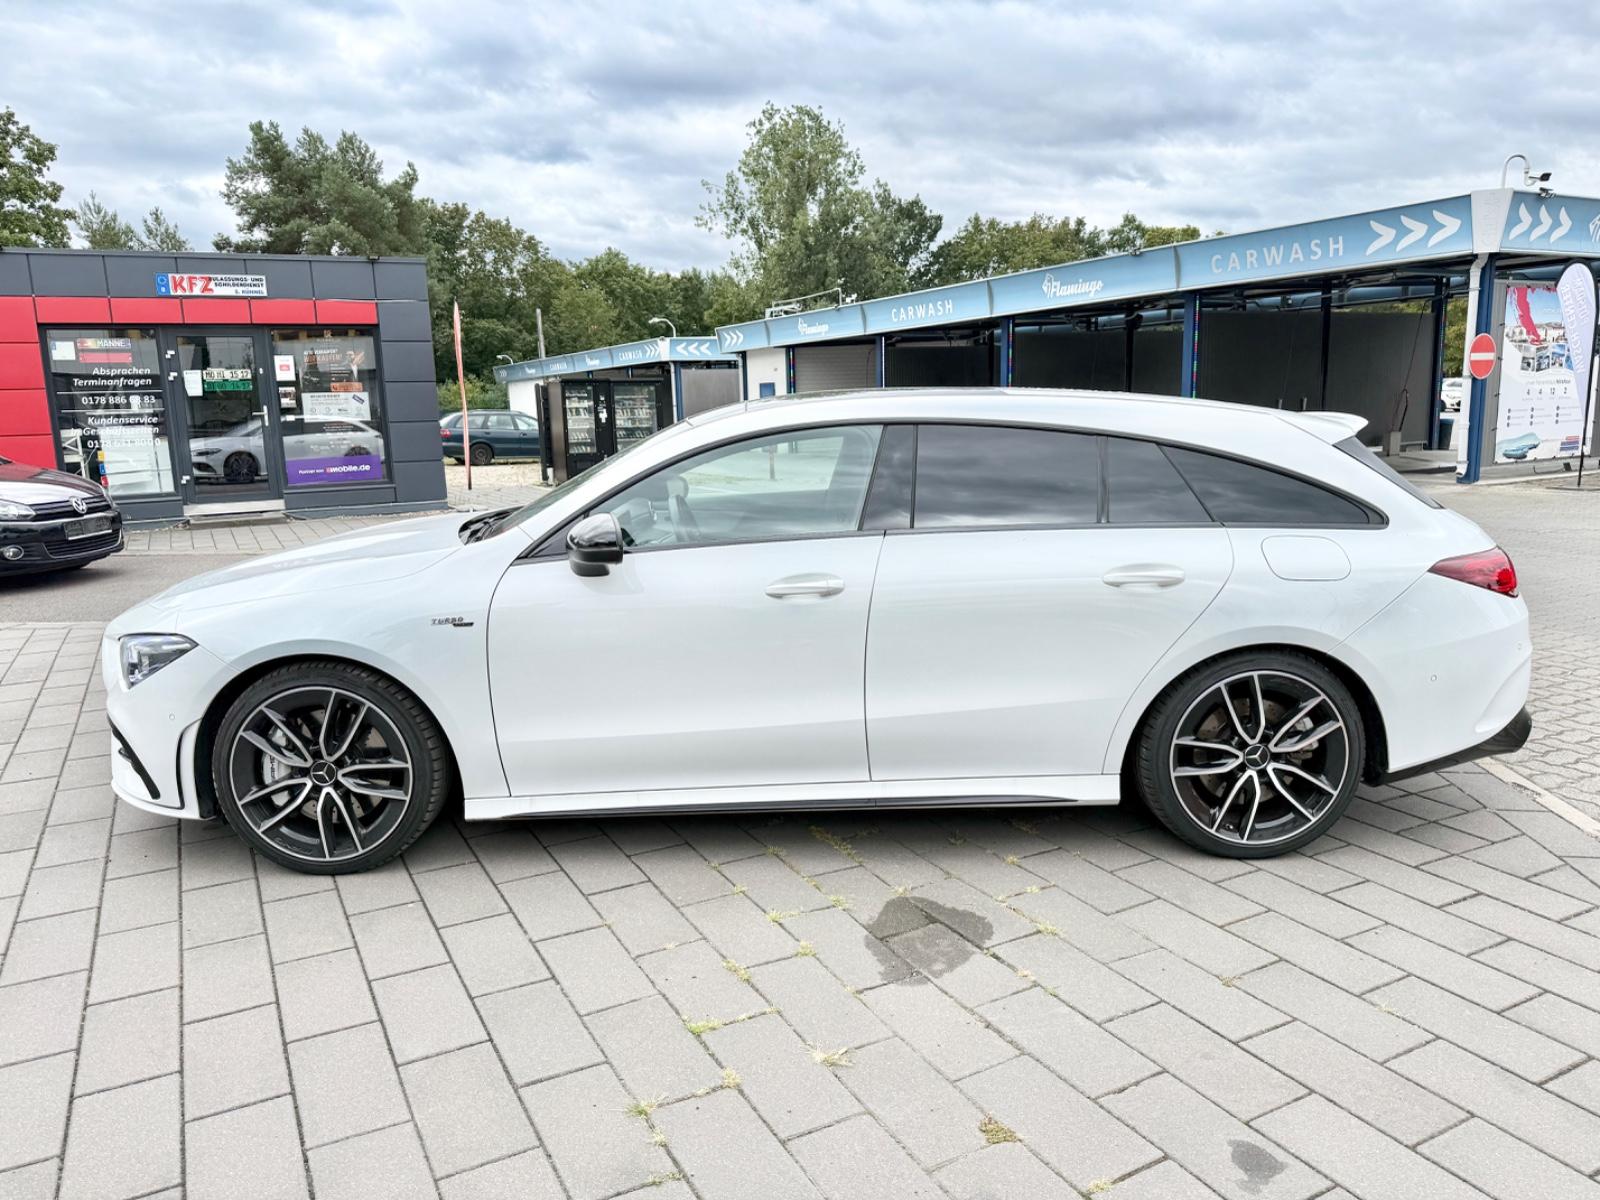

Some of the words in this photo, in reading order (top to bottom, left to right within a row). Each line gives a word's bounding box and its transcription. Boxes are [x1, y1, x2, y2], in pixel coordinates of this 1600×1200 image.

[1211, 236, 1344, 273] CARWASH
[171, 275, 214, 293] KFZ
[1051, 279, 1104, 297] Flamingo
[891, 300, 953, 322] CARWASH
[93, 367, 151, 376] Absprachen
[72, 377, 152, 387] Terminanfragen
[81, 396, 107, 405] 0178
[108, 395, 128, 404] 886
[143, 395, 156, 403] 83
[87, 416, 159, 425] Kundenservice
